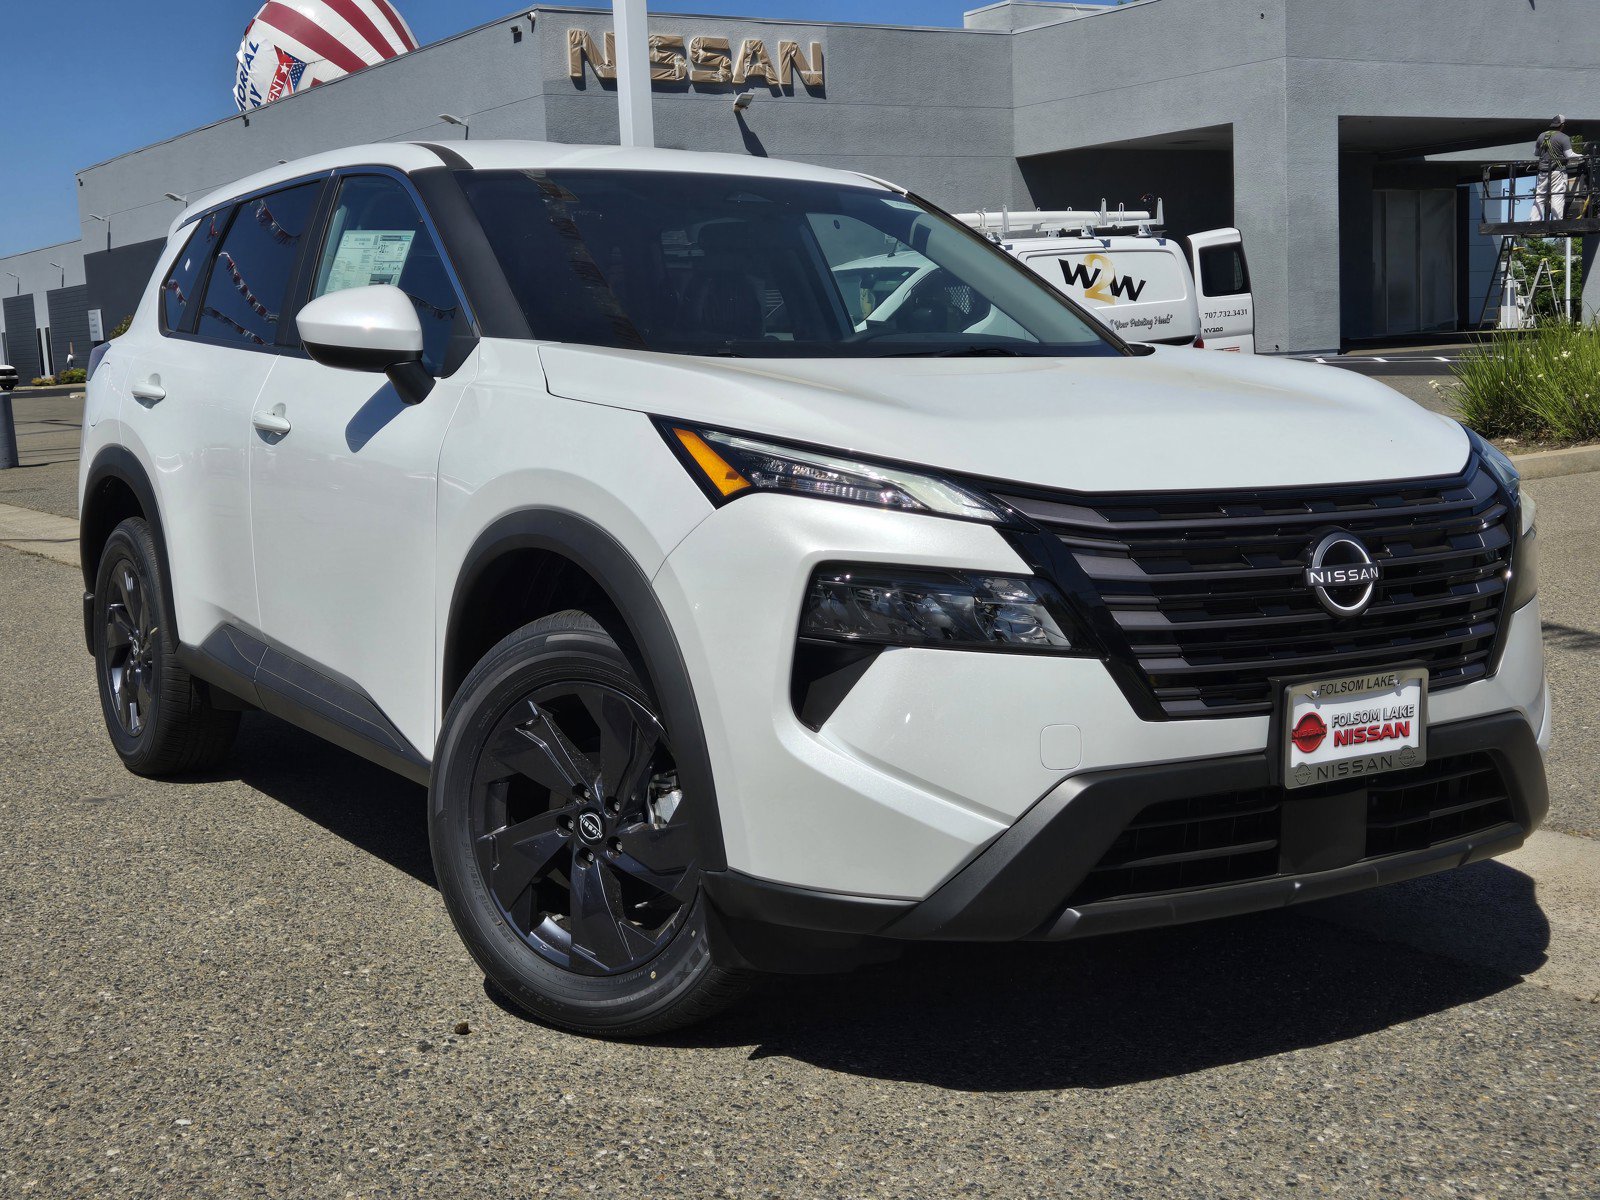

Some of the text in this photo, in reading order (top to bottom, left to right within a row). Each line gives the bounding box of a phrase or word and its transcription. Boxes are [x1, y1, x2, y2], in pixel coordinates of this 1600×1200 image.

[567, 29, 823, 86] NSSAN
[1309, 566, 1379, 584] NISSAN
[1320, 674, 1396, 696] FOLSOM LAKE
[1331, 703, 1415, 729] FOLSOM LAKE
[1292, 725, 1328, 740] NISSAN
[1333, 720, 1411, 748] NISSAN
[1317, 754, 1393, 780] NISSAN
